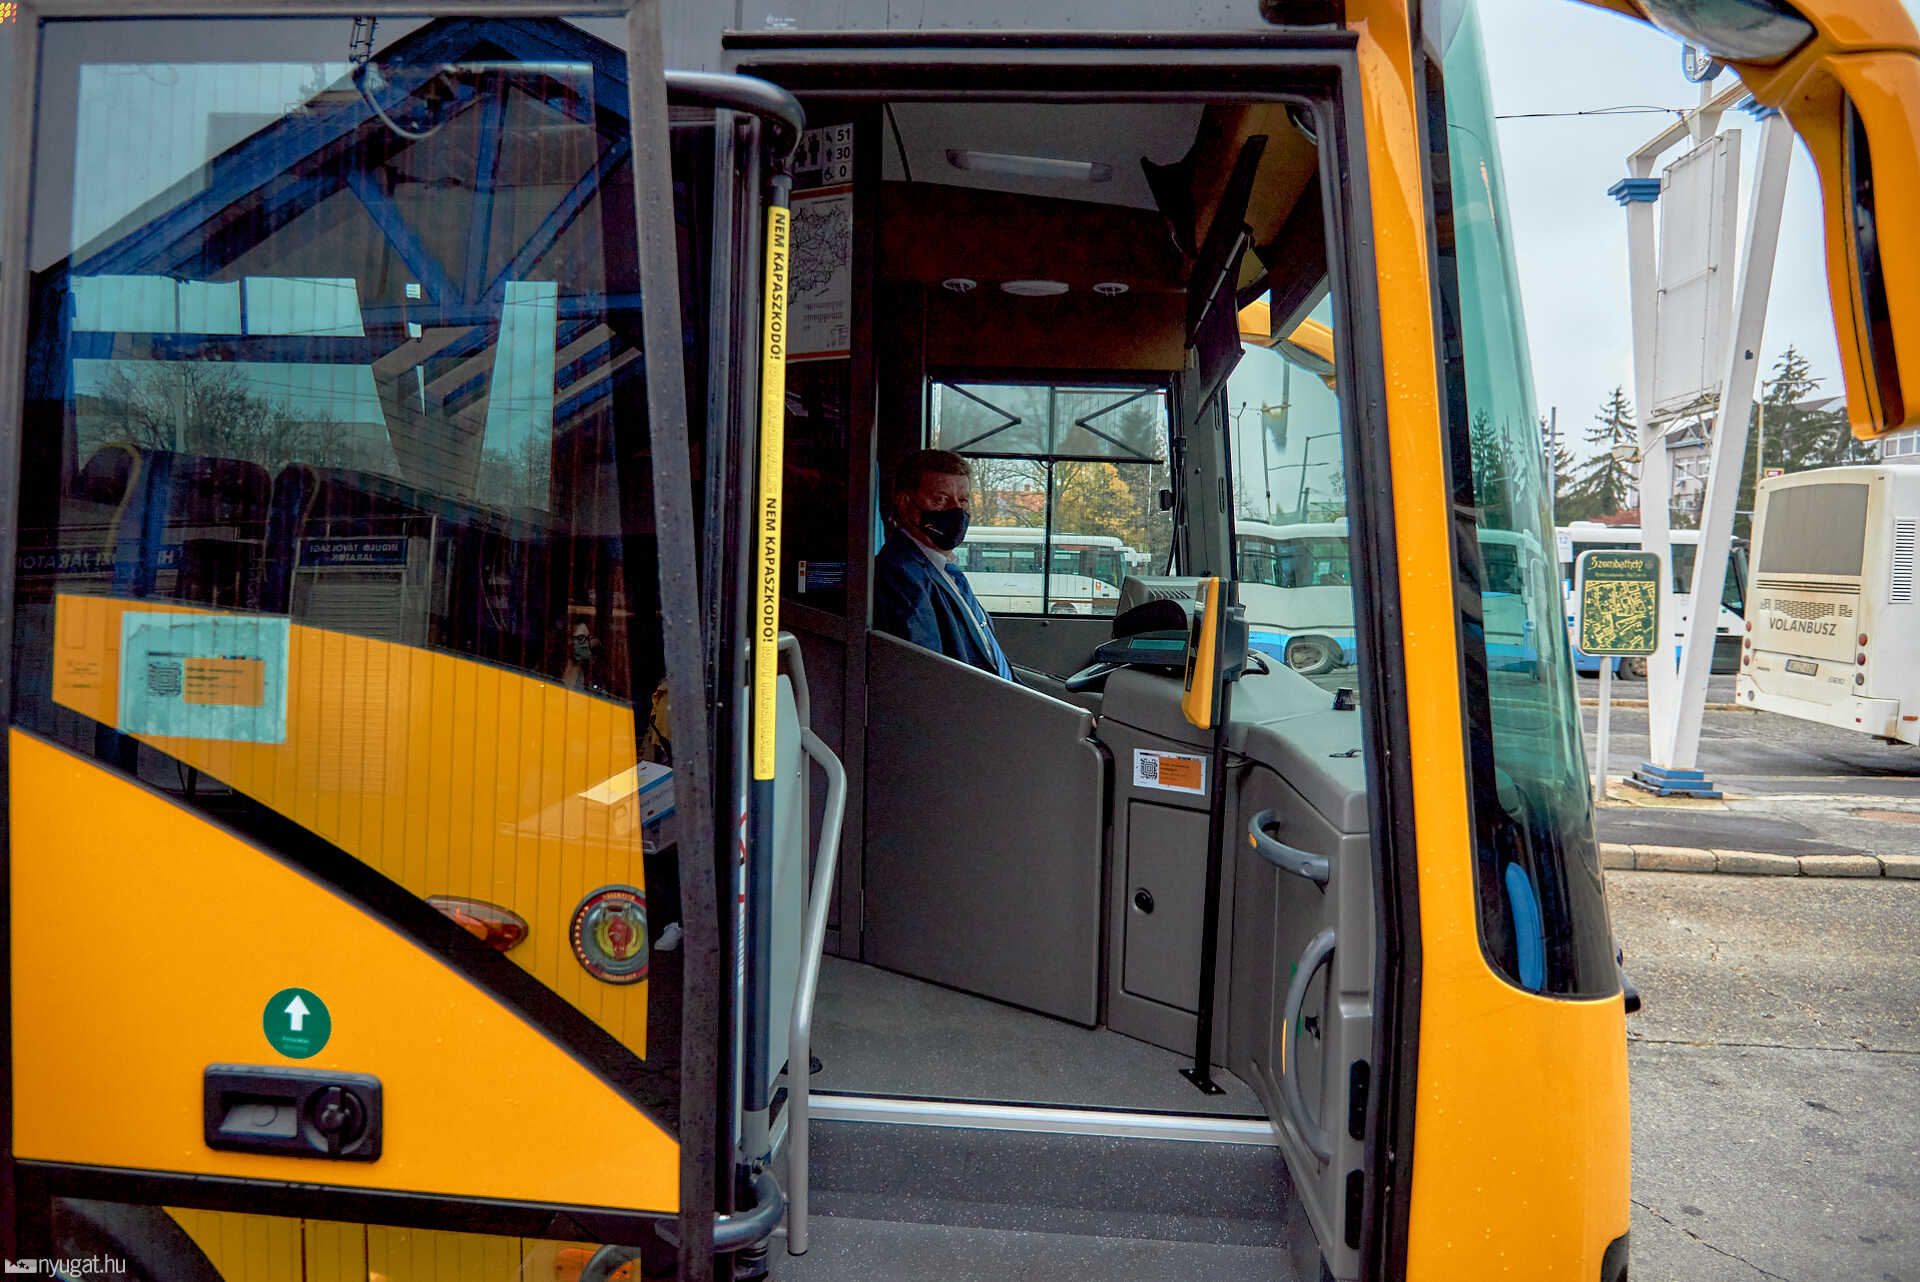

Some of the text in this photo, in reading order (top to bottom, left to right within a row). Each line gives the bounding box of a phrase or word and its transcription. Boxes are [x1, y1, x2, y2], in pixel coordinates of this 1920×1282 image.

[836, 146, 850, 160] 30
[837, 128, 850, 142] 51
[840, 165, 847, 177] 0
[773, 212, 786, 249] NEM
[770, 252, 784, 360] KAPASZKODÓ!
[765, 497, 777, 533] NEM
[762, 535, 776, 643] KAPASZKODÓ!
